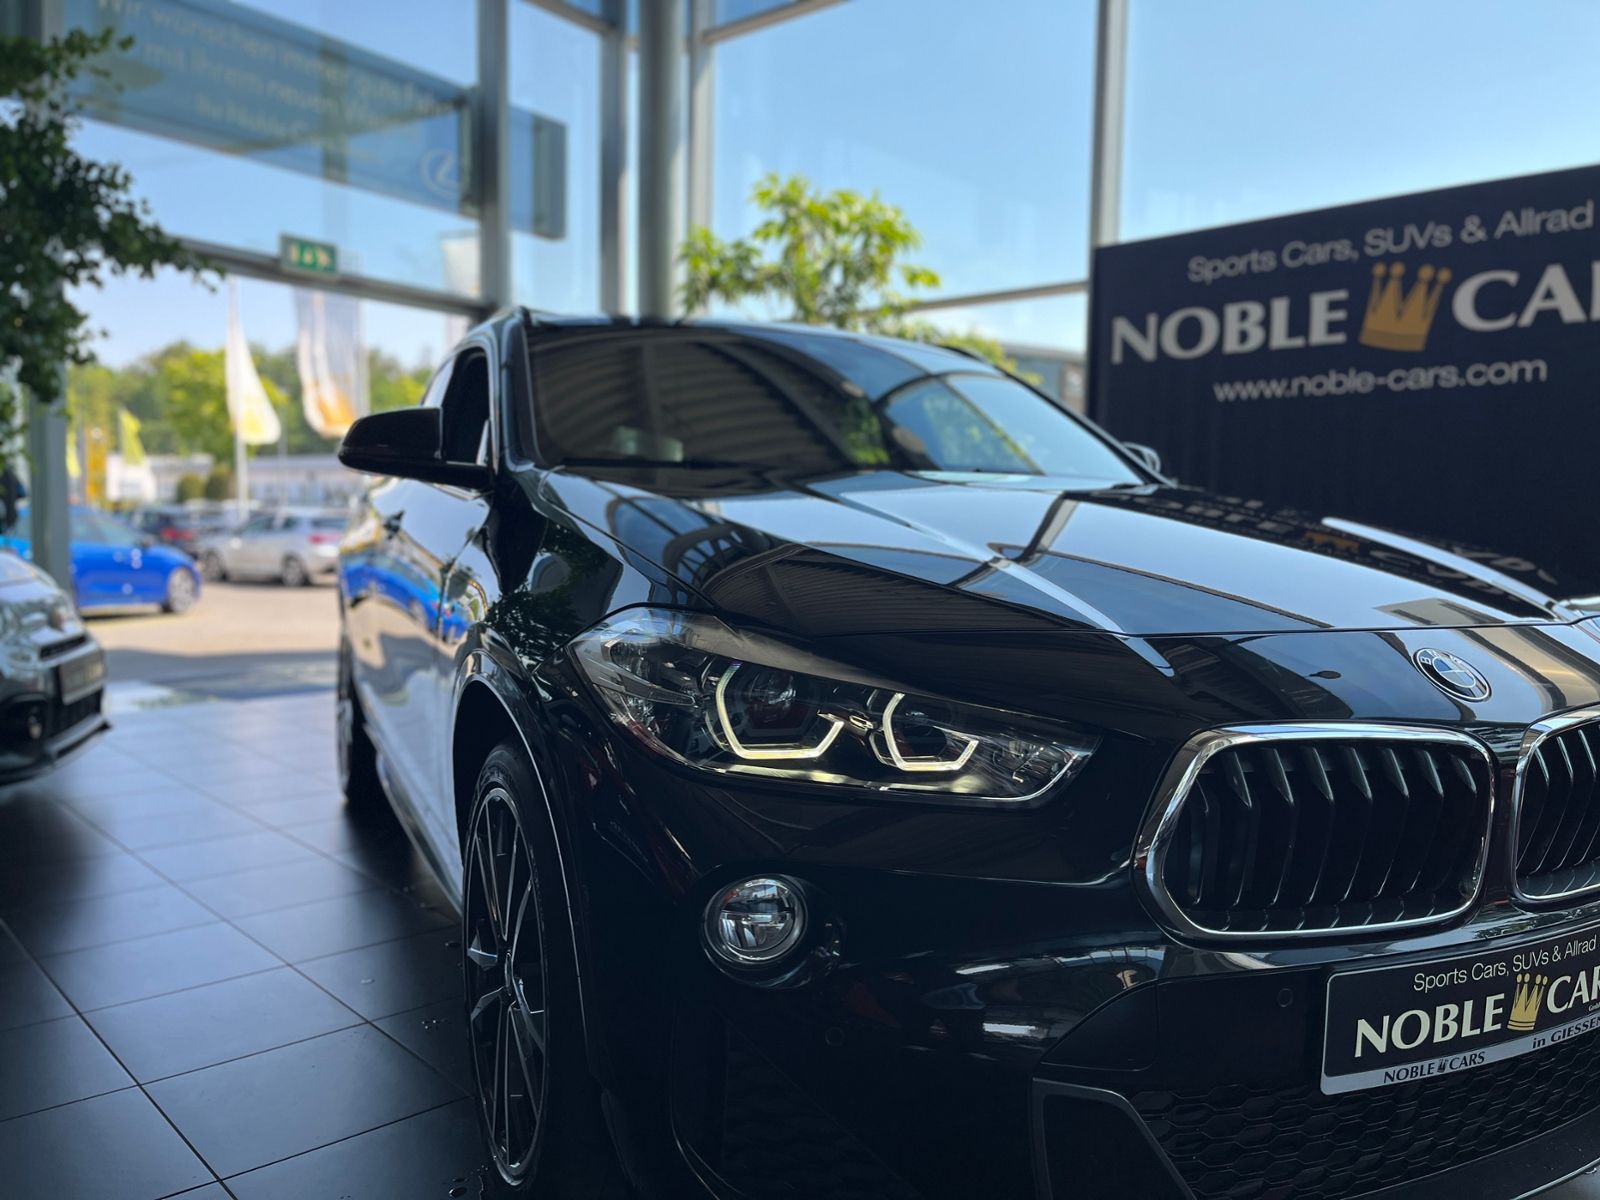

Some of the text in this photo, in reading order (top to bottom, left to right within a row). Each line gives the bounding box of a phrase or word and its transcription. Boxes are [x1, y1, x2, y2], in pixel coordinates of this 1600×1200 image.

[1187, 199, 1594, 284] Sports Cars, SUVs & Allrad
[1111, 260, 1600, 364] NOBLE CA
[1213, 358, 1548, 402] www.noble-cars.com
[1413, 934, 1597, 993] Sports Cars, SUVs & Allrad
[1354, 993, 1505, 1058] NOBLE
[1532, 1037, 1546, 1049] in
[1383, 1051, 1486, 1084] NOBLE CARS
